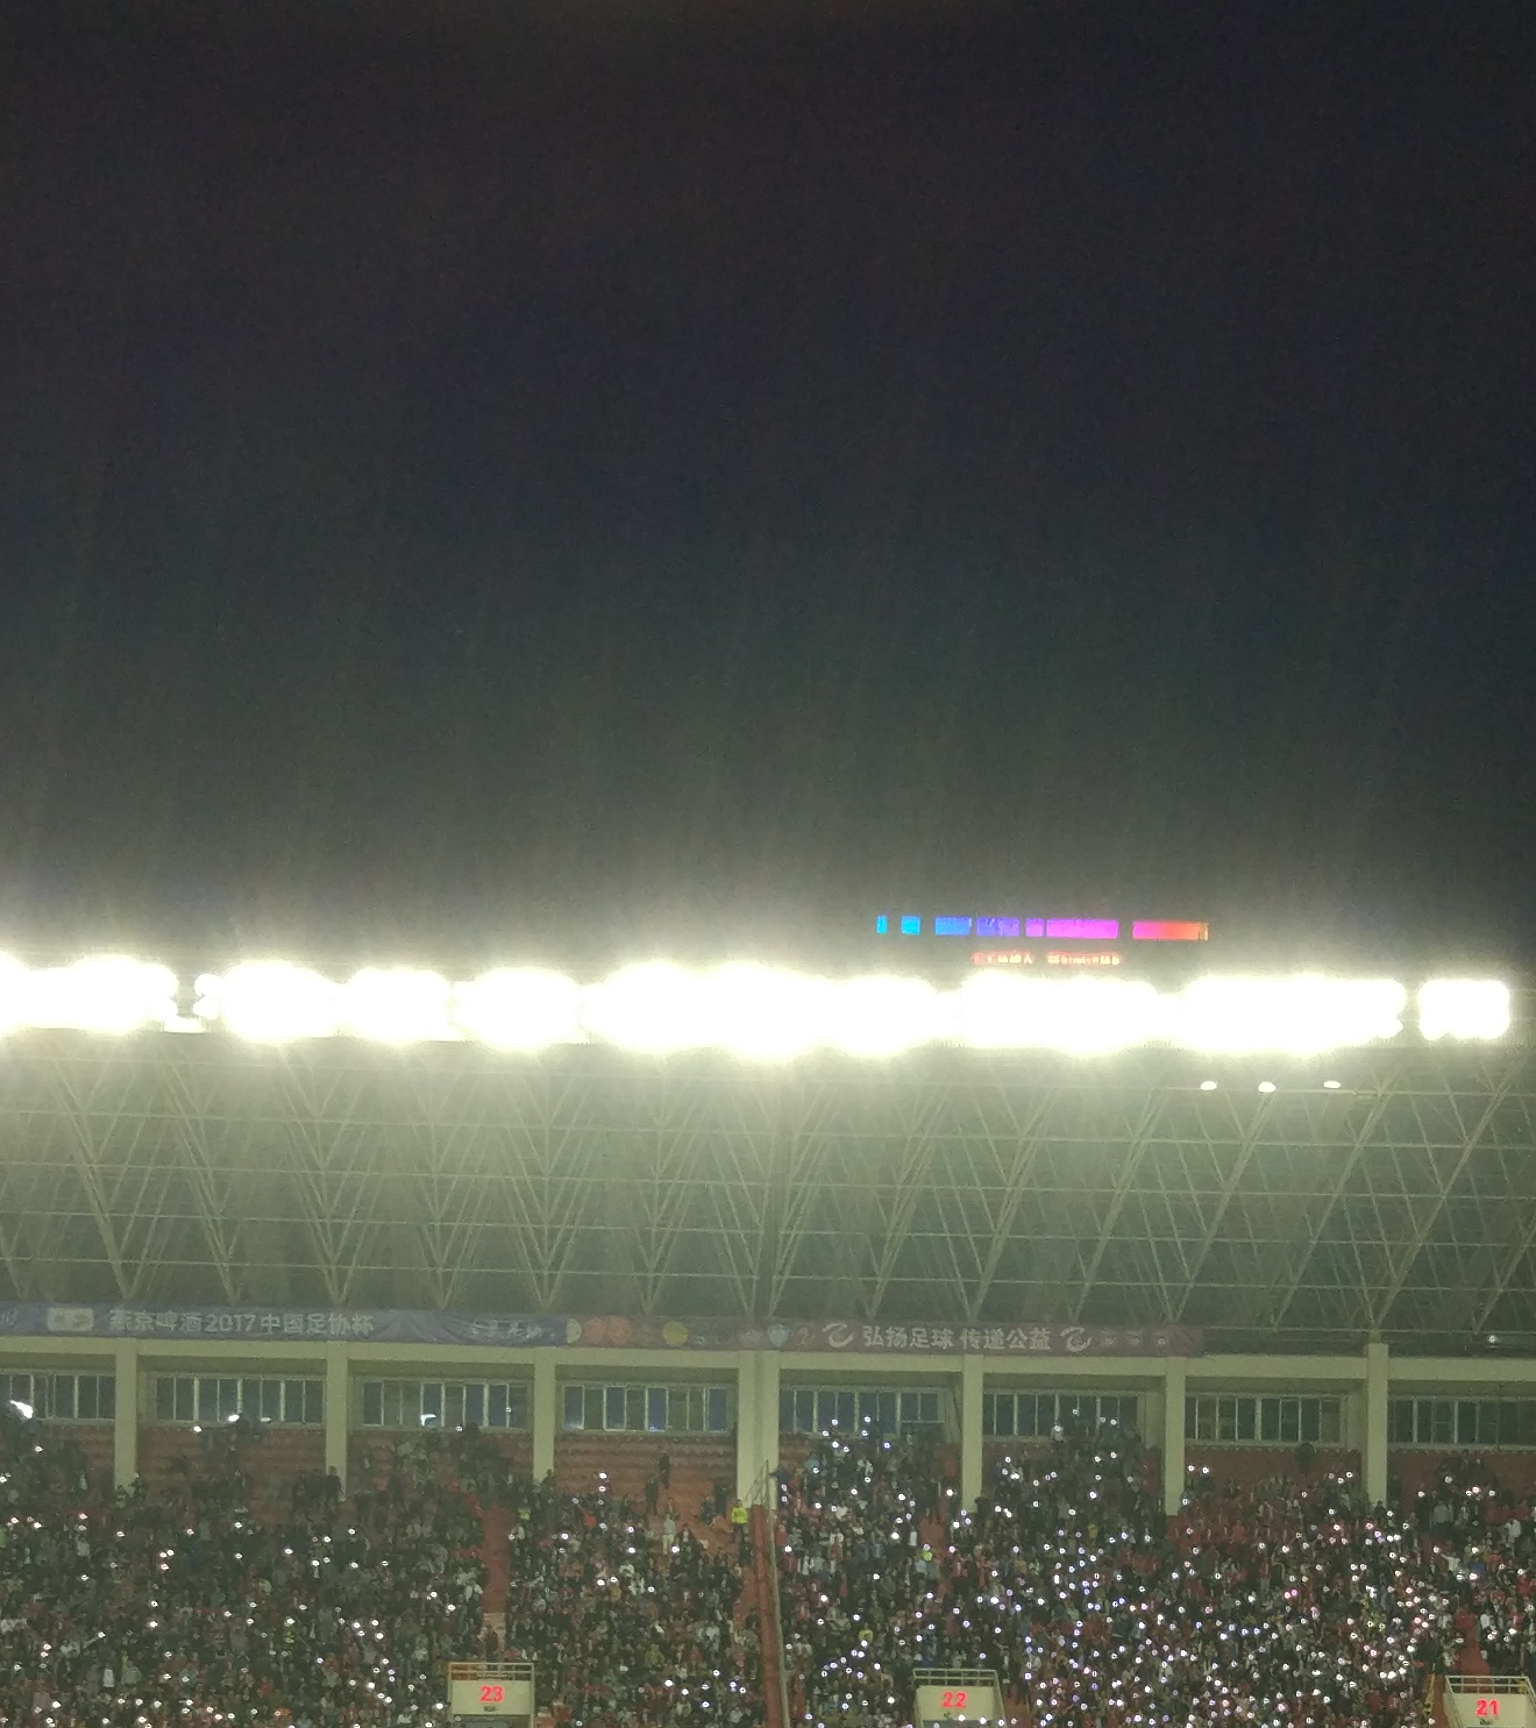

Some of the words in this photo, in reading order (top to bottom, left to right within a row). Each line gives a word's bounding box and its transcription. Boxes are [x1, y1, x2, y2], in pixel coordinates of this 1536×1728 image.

[480, 1685, 505, 1703] 23
[941, 1691, 968, 1709] 22
[1476, 1699, 1500, 1717] 21
